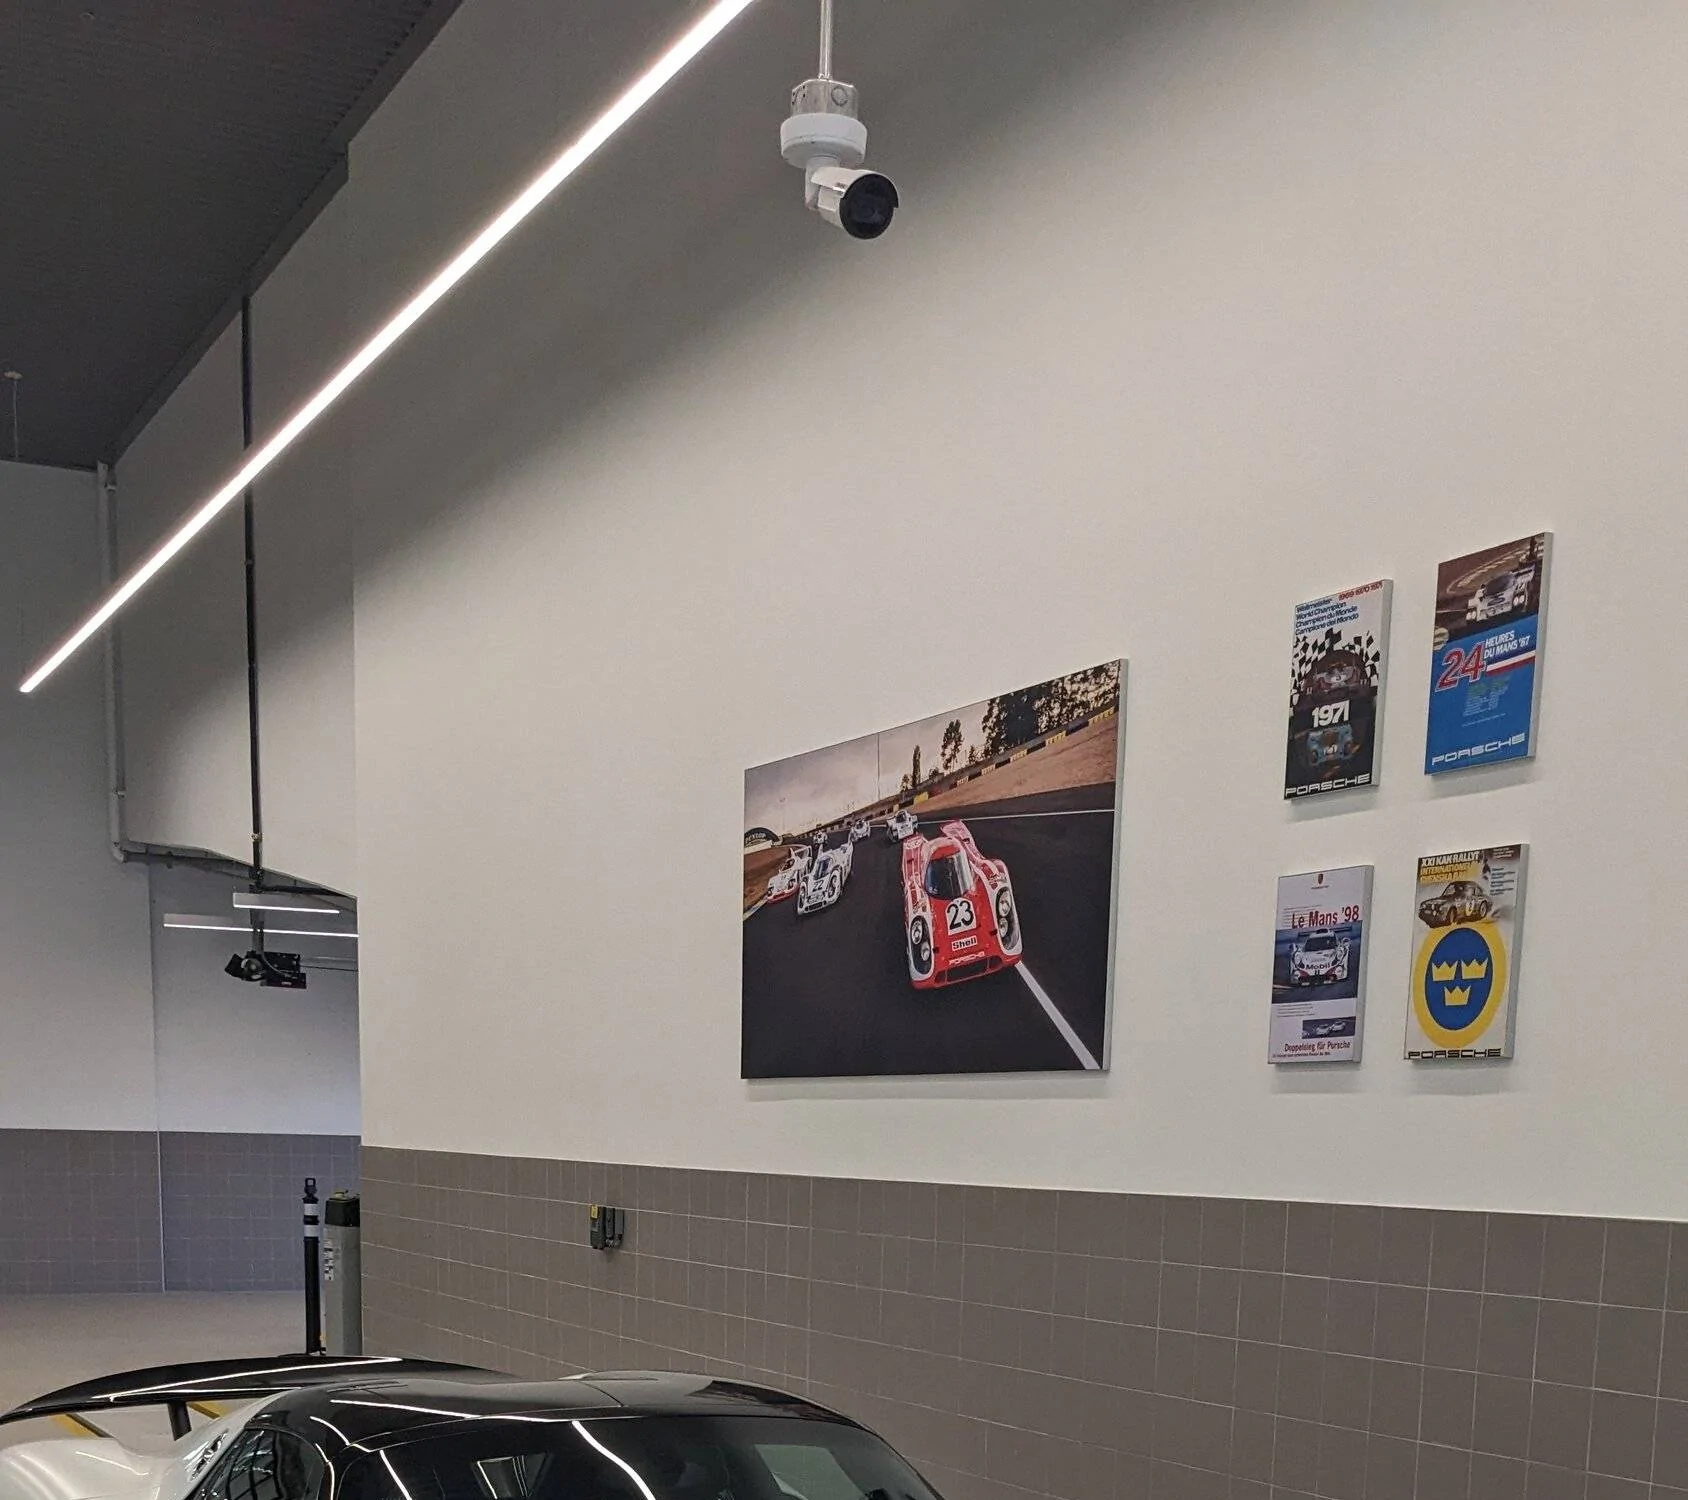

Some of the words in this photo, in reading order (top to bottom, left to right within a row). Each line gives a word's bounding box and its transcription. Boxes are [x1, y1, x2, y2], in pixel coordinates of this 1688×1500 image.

[1296, 610, 1314, 620] World
[1336, 605, 1358, 616] Monde
[1295, 621, 1327, 636] Campione
[1336, 613, 1359, 624] Mondo
[1483, 647, 1496, 659] DU
[1495, 639, 1518, 655] MANS
[1485, 630, 1515, 649] HEURES
[1435, 641, 1486, 692] 24
[1311, 699, 1350, 728] 1971
[1432, 732, 1526, 766] PORSCHE
[1285, 773, 1371, 797] PORSCHE
[946, 900, 975, 930] 23
[1291, 913, 1305, 929] Le
[1308, 910, 1338, 927] Mans
[1341, 905, 1360, 922] '98
[952, 937, 977, 950] Shell
[1284, 1042, 1316, 1053] Doppelsieg
[1317, 1041, 1326, 1051] für
[1327, 1041, 1351, 1050] Porsche
[1408, 1048, 1502, 1060] PORSCHE
